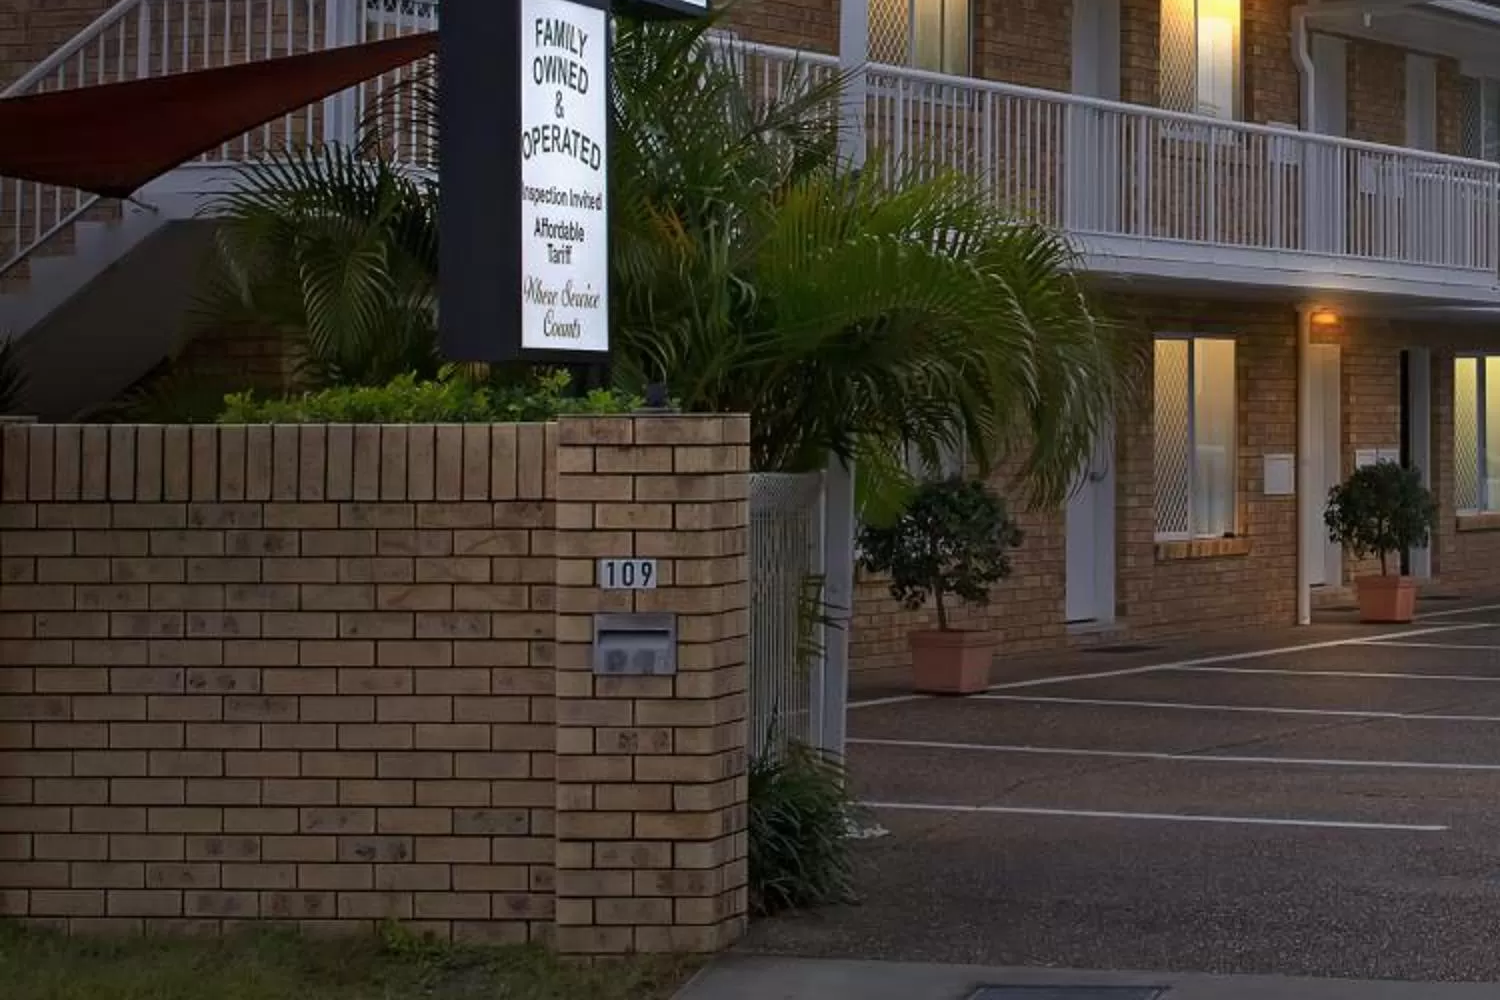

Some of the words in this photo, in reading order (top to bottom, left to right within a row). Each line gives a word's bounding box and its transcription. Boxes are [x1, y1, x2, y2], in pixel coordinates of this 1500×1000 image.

[535, 18, 588, 59] FAMILY
[533, 59, 589, 95] OWNED
[554, 91, 565, 120] &
[522, 124, 602, 172] OPERATED
[569, 187, 603, 212] Invited
[534, 217, 585, 243] Affordable
[547, 243, 573, 265] Tariff
[606, 562, 653, 587] 109
